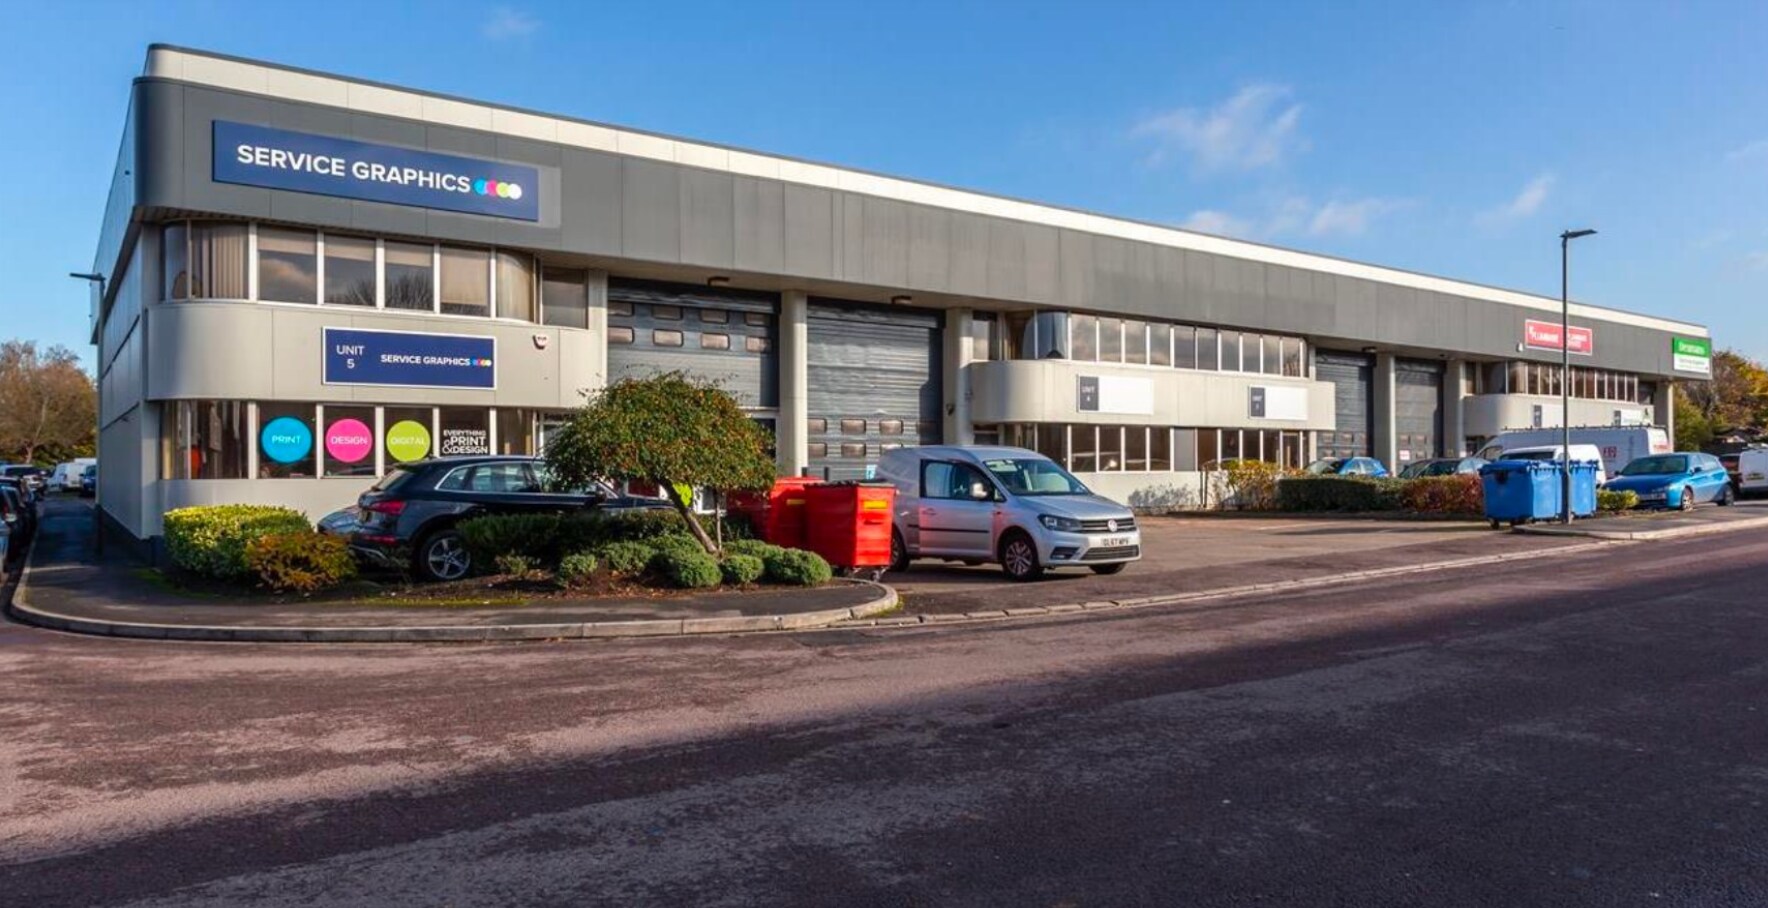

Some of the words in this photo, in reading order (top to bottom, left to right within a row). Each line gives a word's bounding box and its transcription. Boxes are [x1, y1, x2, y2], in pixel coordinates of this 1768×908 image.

[236, 144, 346, 177] SERVICE
[351, 161, 471, 194] GRAPHICS
[336, 344, 365, 355] UNIT
[346, 358, 355, 369] 5
[380, 354, 421, 364] SERVICE
[423, 356, 470, 366] GRAPHICS
[443, 429, 487, 437] EVERYTHING
[271, 435, 301, 444] PRINT
[331, 436, 368, 445] DESIGN
[391, 437, 425, 446] DIGITAL
[450, 436, 486, 446] PRINT
